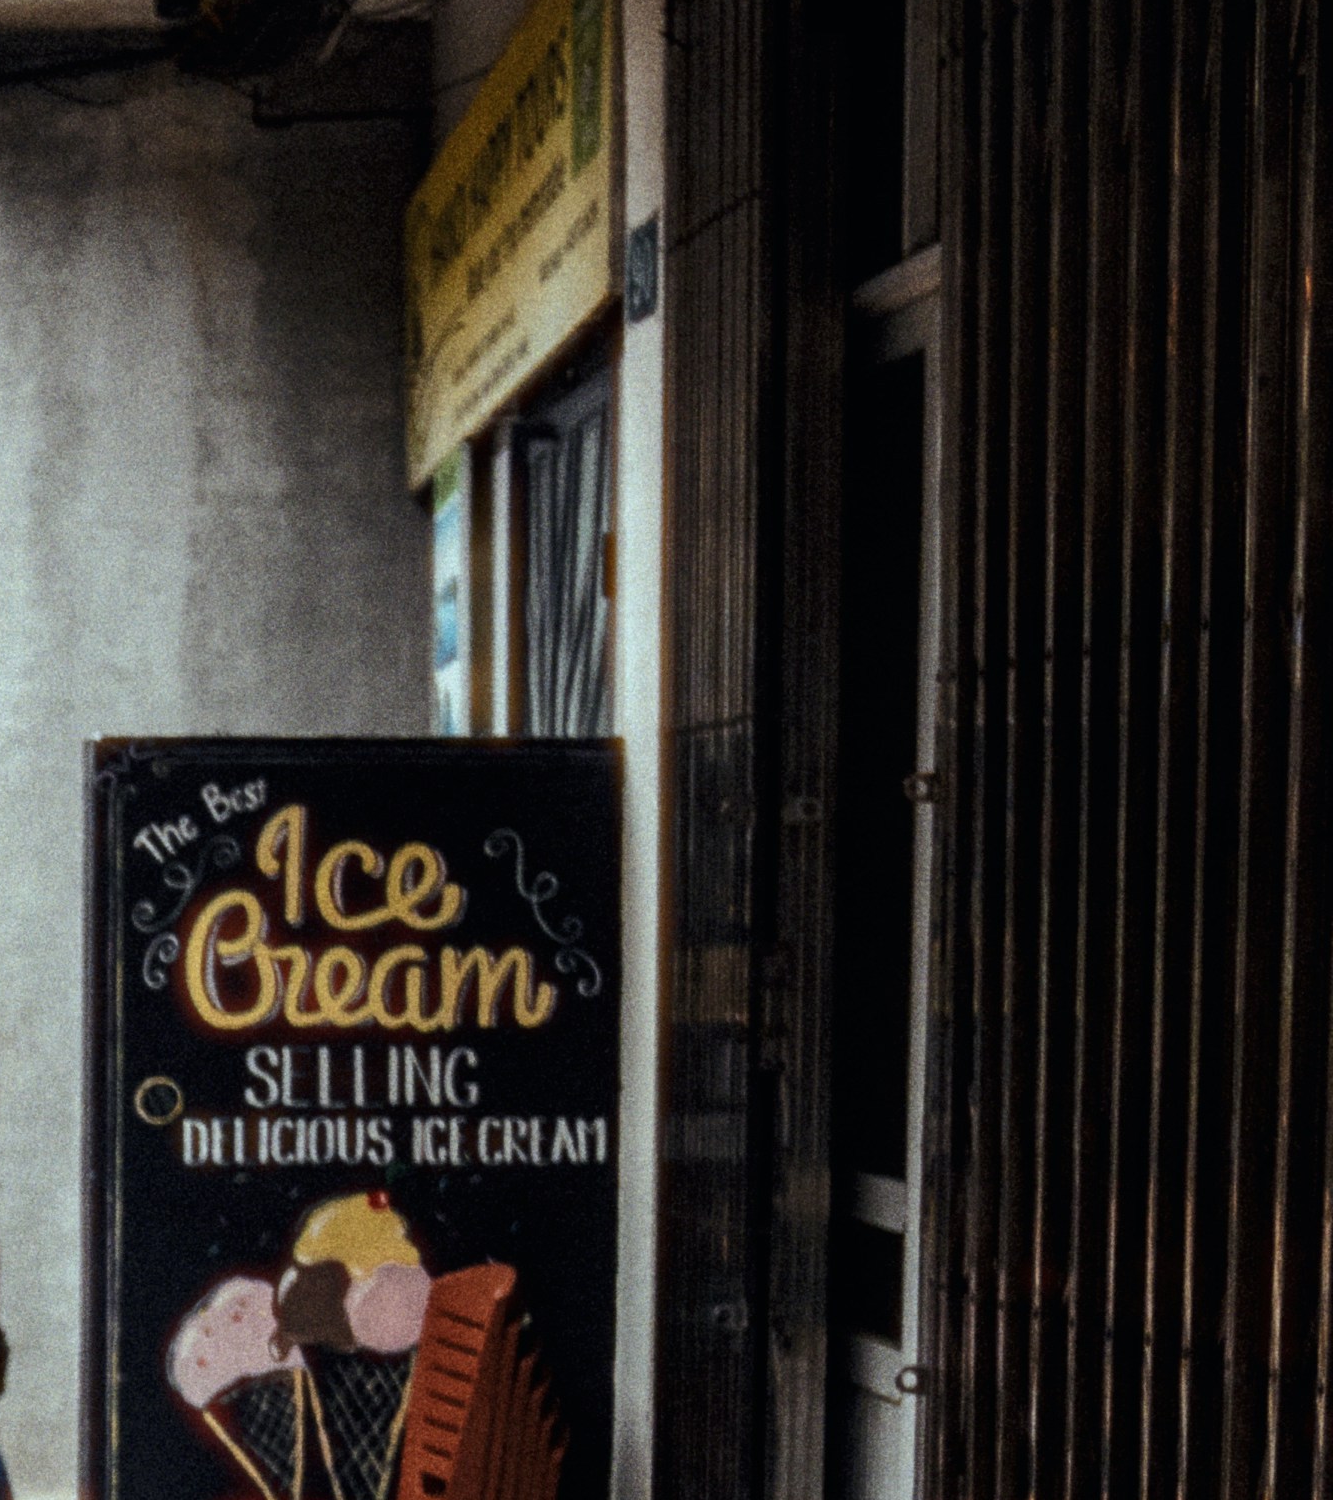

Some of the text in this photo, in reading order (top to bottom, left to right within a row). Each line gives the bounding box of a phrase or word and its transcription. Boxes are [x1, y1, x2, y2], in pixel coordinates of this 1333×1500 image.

[134, 776, 268, 865] The Best
[255, 804, 467, 930] Ice
[184, 889, 557, 1032] Cream
[243, 1044, 480, 1109] SELLING
[182, 1115, 608, 1166] DELICIOUS ICE CREAM
